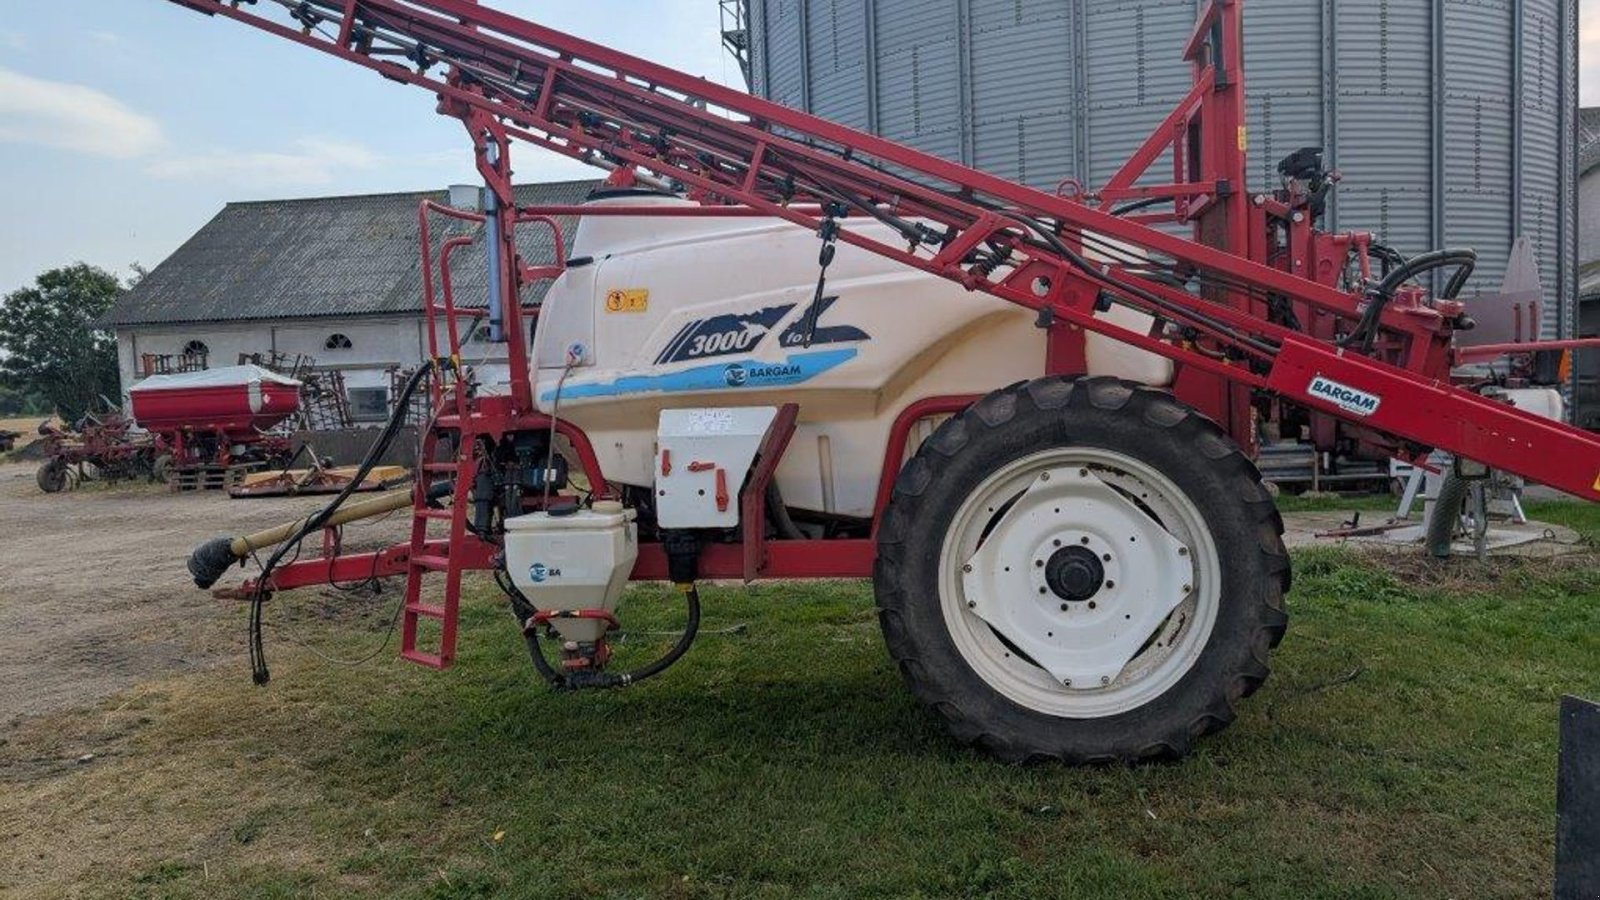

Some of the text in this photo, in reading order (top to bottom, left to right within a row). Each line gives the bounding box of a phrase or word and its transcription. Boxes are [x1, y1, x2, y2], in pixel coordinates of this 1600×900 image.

[689, 330, 751, 356] 3000
[749, 365, 801, 378] BARGAM
[1312, 381, 1376, 411] BARGAM
